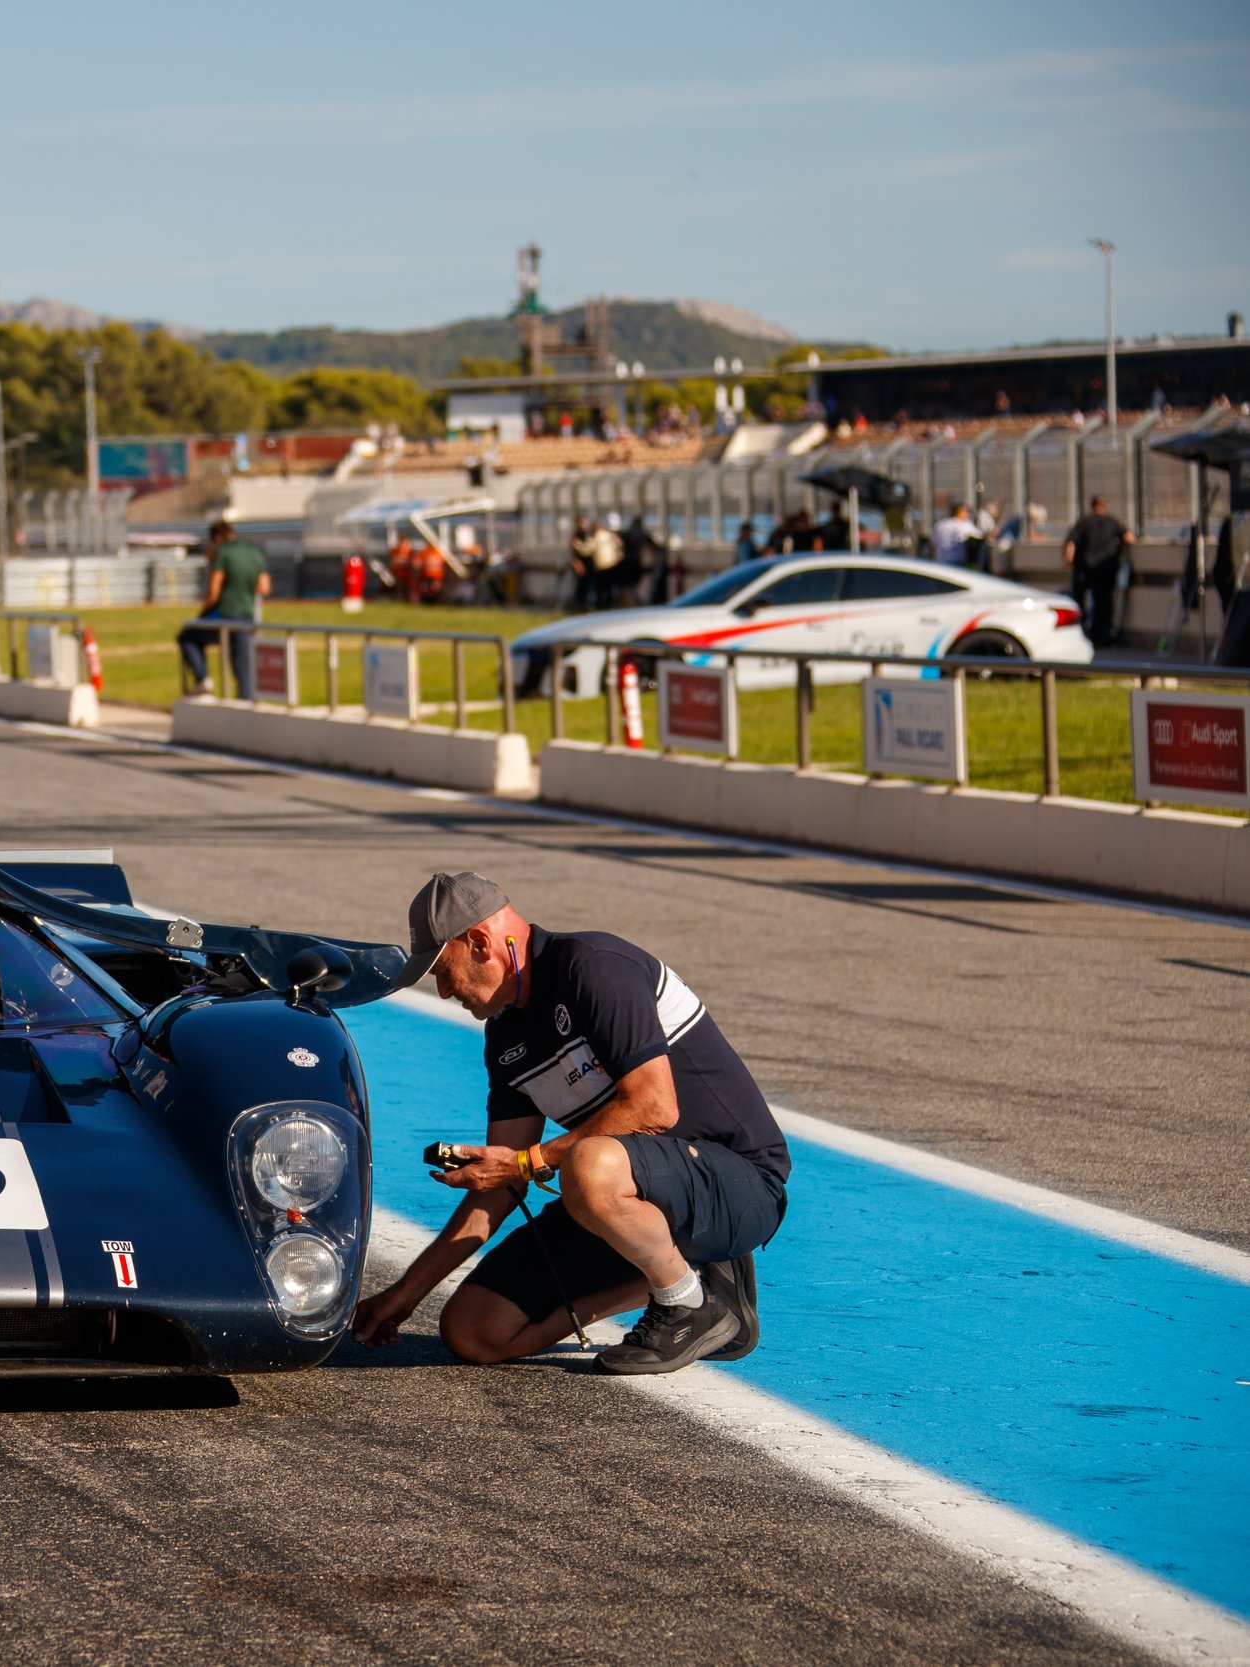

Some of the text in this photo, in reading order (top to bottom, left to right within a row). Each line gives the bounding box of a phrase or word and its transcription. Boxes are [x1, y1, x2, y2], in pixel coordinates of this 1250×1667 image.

[1192, 722, 1238, 749] Audi Sport
[103, 1241, 132, 1252] TOW
